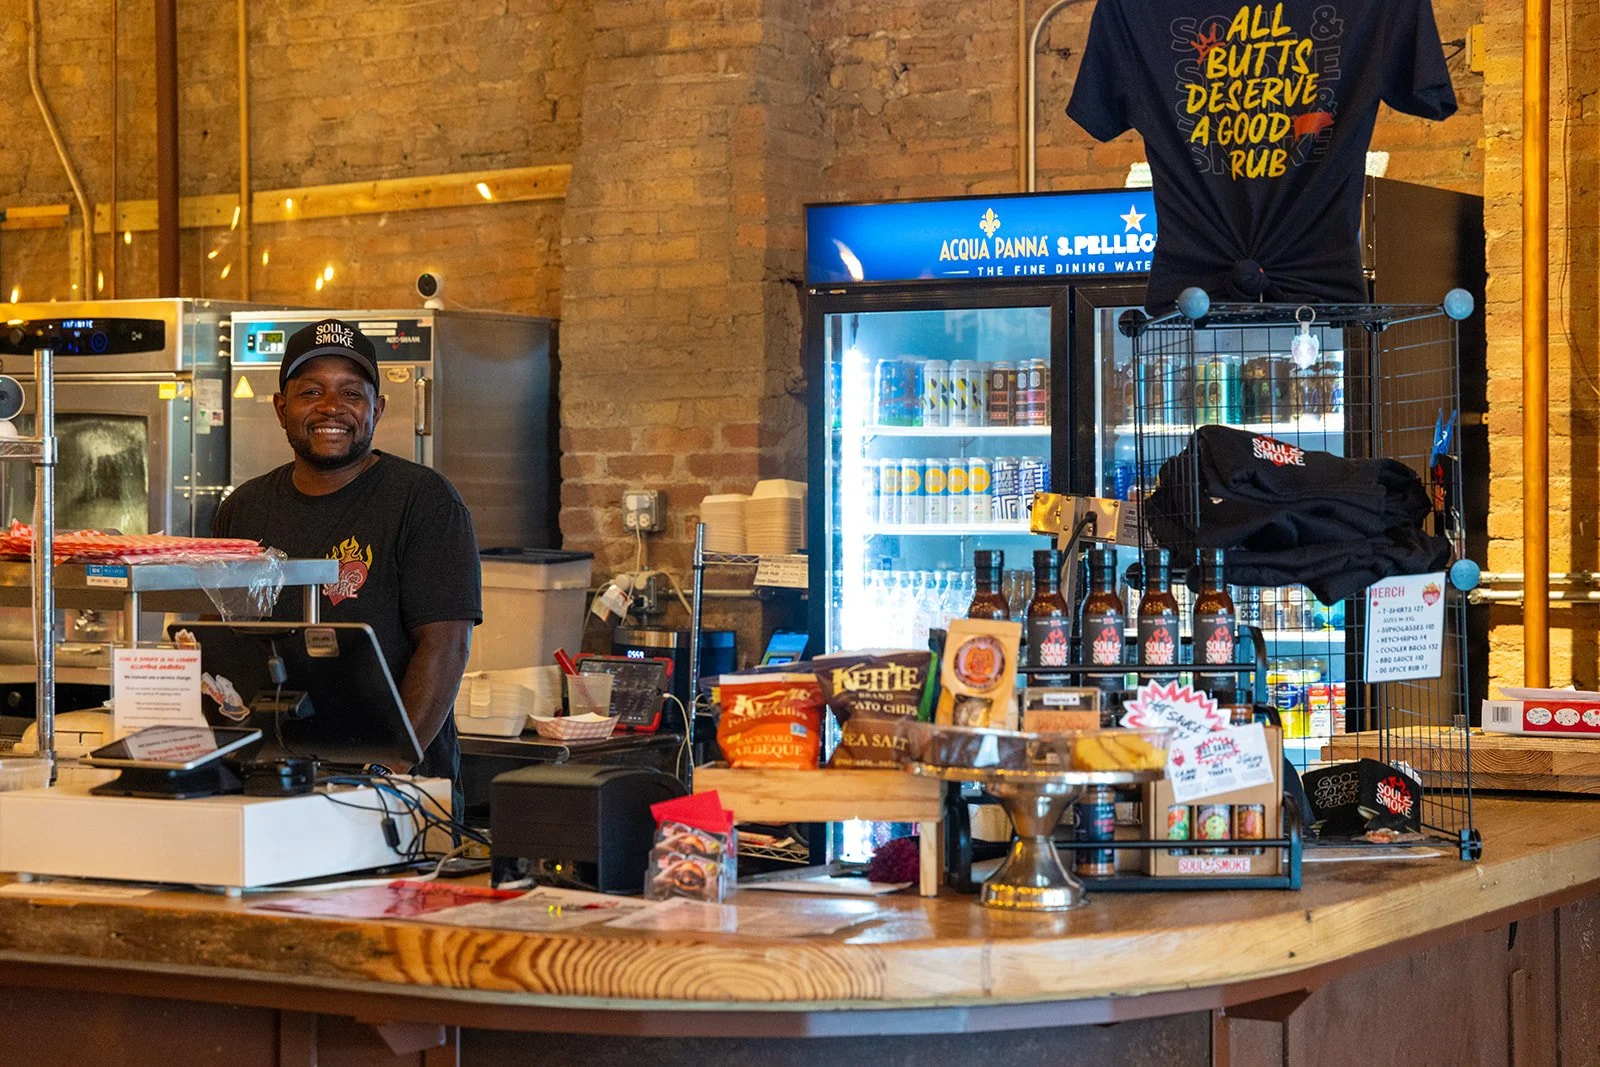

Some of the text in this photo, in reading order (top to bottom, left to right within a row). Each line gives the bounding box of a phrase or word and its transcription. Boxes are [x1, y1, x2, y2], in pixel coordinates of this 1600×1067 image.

[1226, 2, 1291, 41] ALL
[1206, 38, 1313, 79] BUTTS
[1185, 73, 1320, 114] DESERVE
[1190, 115, 1210, 147] A
[1217, 112, 1292, 146] GOOD
[1230, 149, 1288, 182] RUB
[939, 238, 991, 262] ACQUA
[995, 235, 1049, 259] PANNA
[977, 260, 1153, 277] THE FINE DINING WATE
[315, 323, 344, 336] SOUL
[315, 333, 355, 349] SMOKE
[1251, 438, 1289, 456] SOUL
[1253, 446, 1306, 467] SMOKE
[1040, 642, 1062, 655] SOUL
[1092, 640, 1115, 653] SOUL
[1145, 641, 1168, 654] SOUL
[1205, 640, 1228, 653] SOUL
[1040, 654, 1068, 666] SMOKE
[1092, 652, 1120, 664] SMOKE
[1145, 653, 1174, 665] SMOKE
[1205, 652, 1233, 664] SMOKE
[831, 661, 923, 697] KETTLE
[882, 704, 919, 717] CHIPS
[872, 733, 909, 751] SALT
[1376, 782, 1404, 803] SOUL
[1376, 792, 1412, 818] SMOKE
[1178, 858, 1203, 874] SOUL
[1214, 858, 1249, 873] SMOKE
